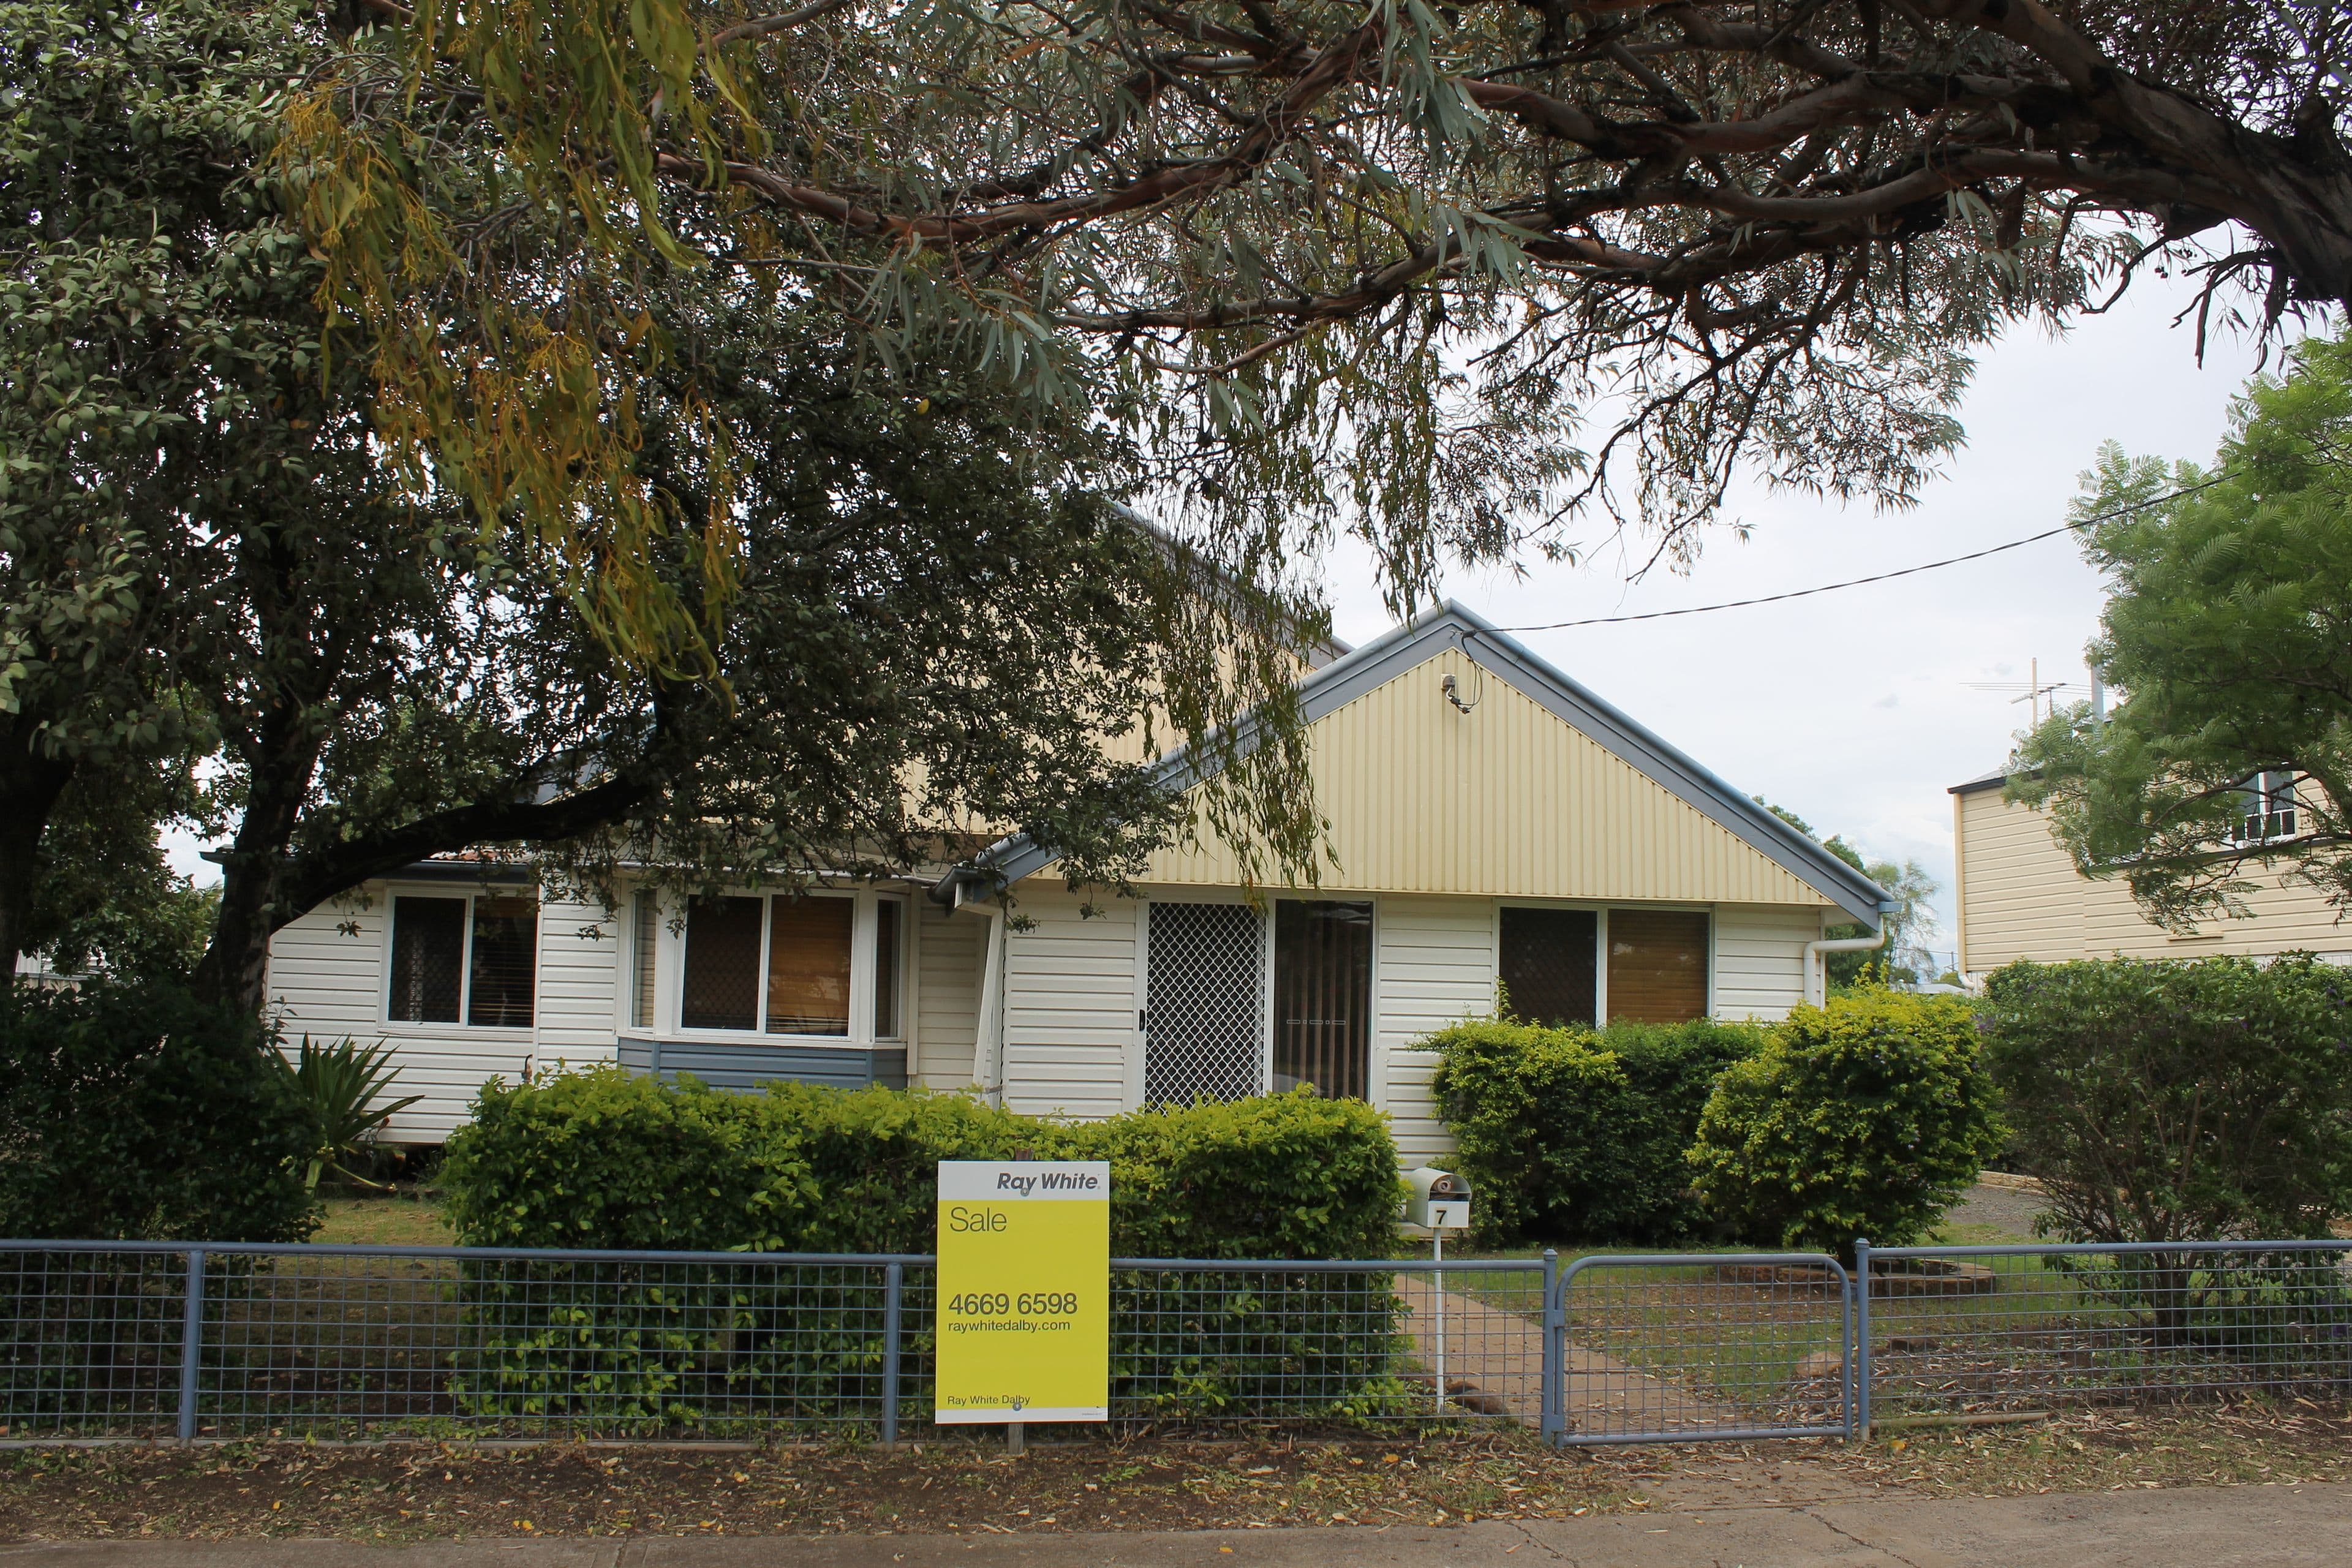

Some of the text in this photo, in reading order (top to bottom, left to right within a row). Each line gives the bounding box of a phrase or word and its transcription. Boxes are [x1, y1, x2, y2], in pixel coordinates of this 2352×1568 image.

[997, 1172, 1098, 1189] Ray White
[950, 1207, 1007, 1232] Sale
[1436, 1210, 1447, 1224] 7
[948, 1292, 1077, 1315] 4669 6598
[948, 1320, 1070, 1333] raywhitedalby.com
[947, 1394, 1030, 1406] Ray White Dalby
